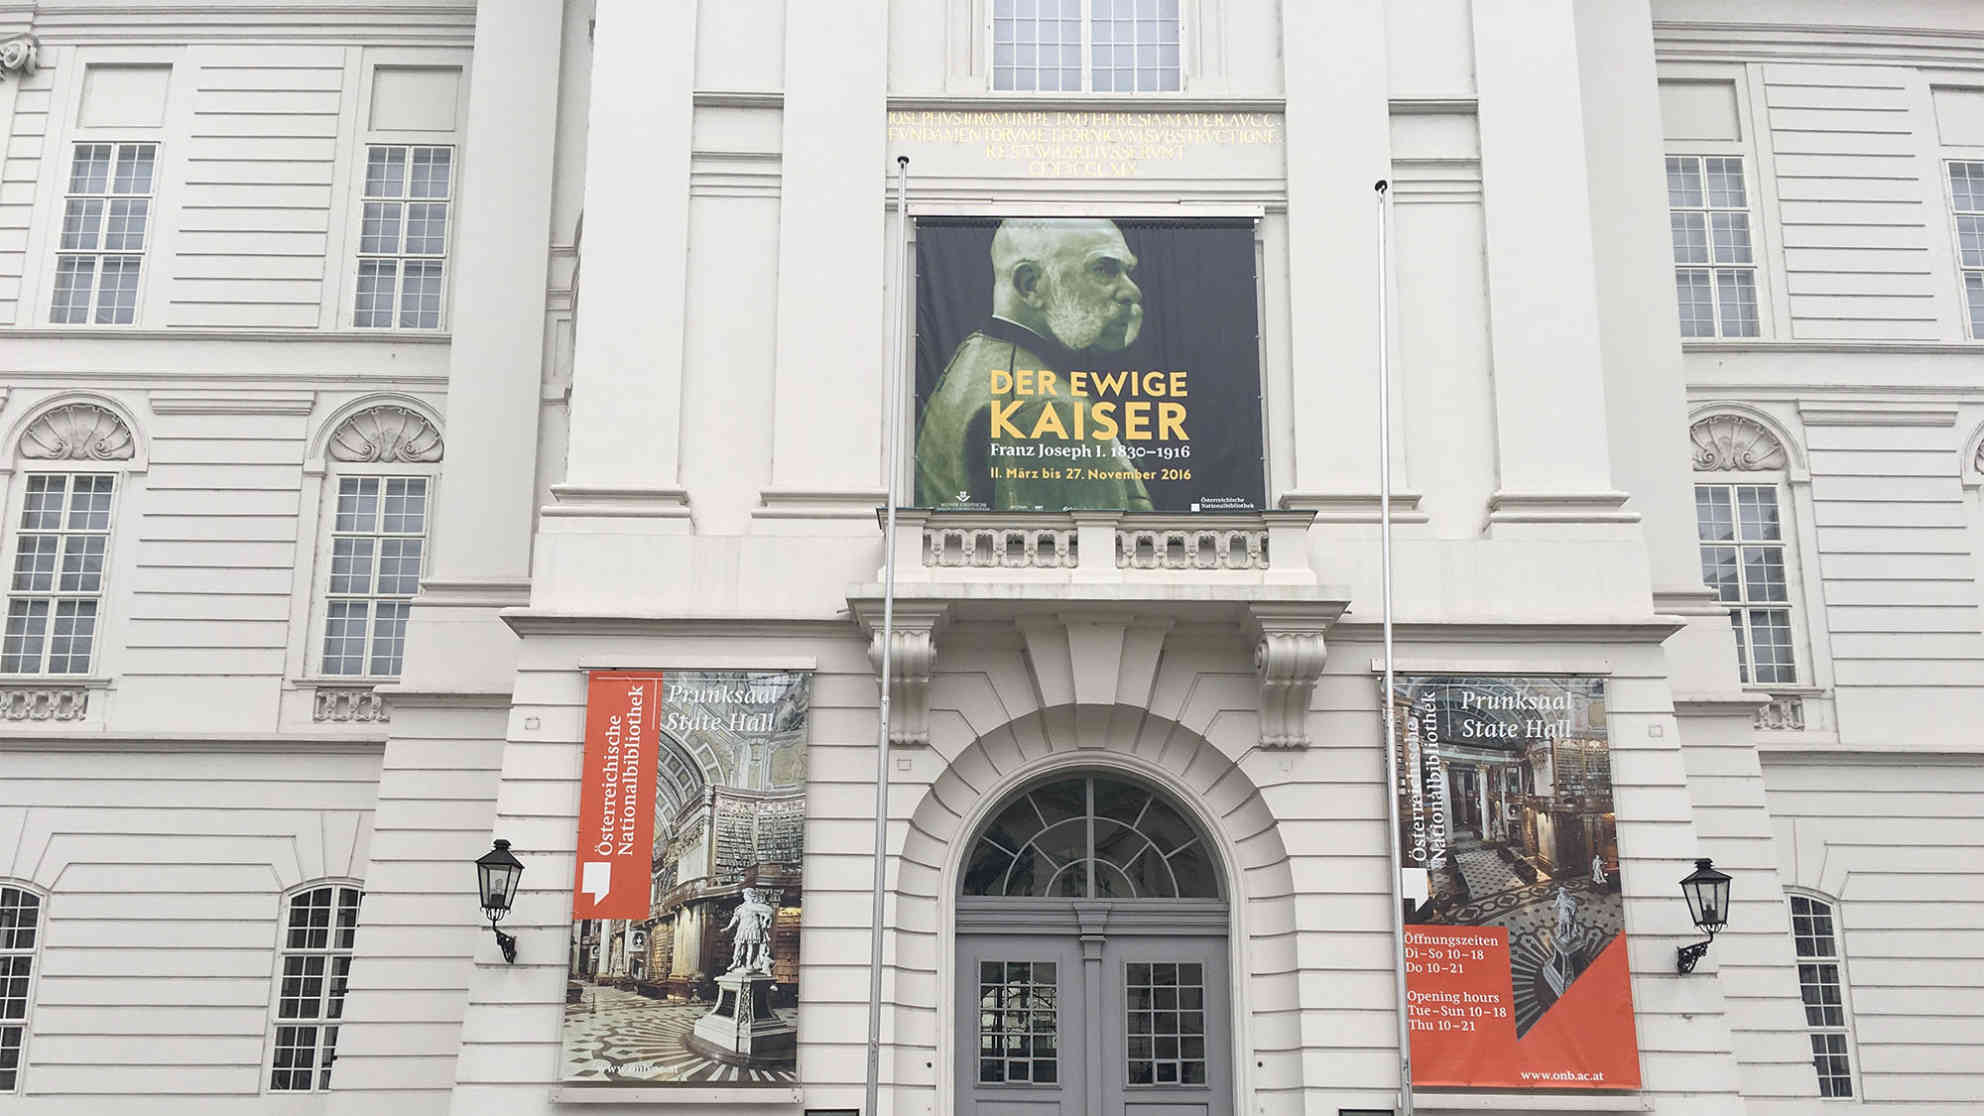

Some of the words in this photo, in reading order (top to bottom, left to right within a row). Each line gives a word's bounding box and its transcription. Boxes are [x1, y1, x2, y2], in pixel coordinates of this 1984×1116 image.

[990, 369, 1057, 396] DER
[1070, 371, 1189, 398] EWIGE
[990, 399, 1190, 441] KAISER
[990, 443, 1035, 458] Franz
[1038, 444, 1092, 461] Joseph
[1096, 445, 1106, 458] I.
[1006, 466, 1039, 480] März
[1042, 466, 1062, 480] bis
[1066, 467, 1085, 480] 27.
[1088, 468, 1157, 481] November
[1161, 468, 1192, 482] 2016
[668, 684, 778, 704] Prunksaal
[1461, 690, 1575, 711] Prunksaal
[668, 712, 721, 731] State
[730, 712, 775, 732] Hall
[1462, 719, 1519, 739] State
[1524, 720, 1572, 739] Hall
[617, 684, 645, 857] Nationalbibliothek
[594, 714, 622, 856] Österreichische
[1404, 931, 1499, 947] Öffnungszeiten
[1405, 962, 1423, 974] Do
[1407, 990, 1460, 1005] Opening
[1463, 991, 1500, 1003] hours
[1409, 1019, 1434, 1031] Thu
[1520, 1070, 1604, 1082] www.onb.ac.at
